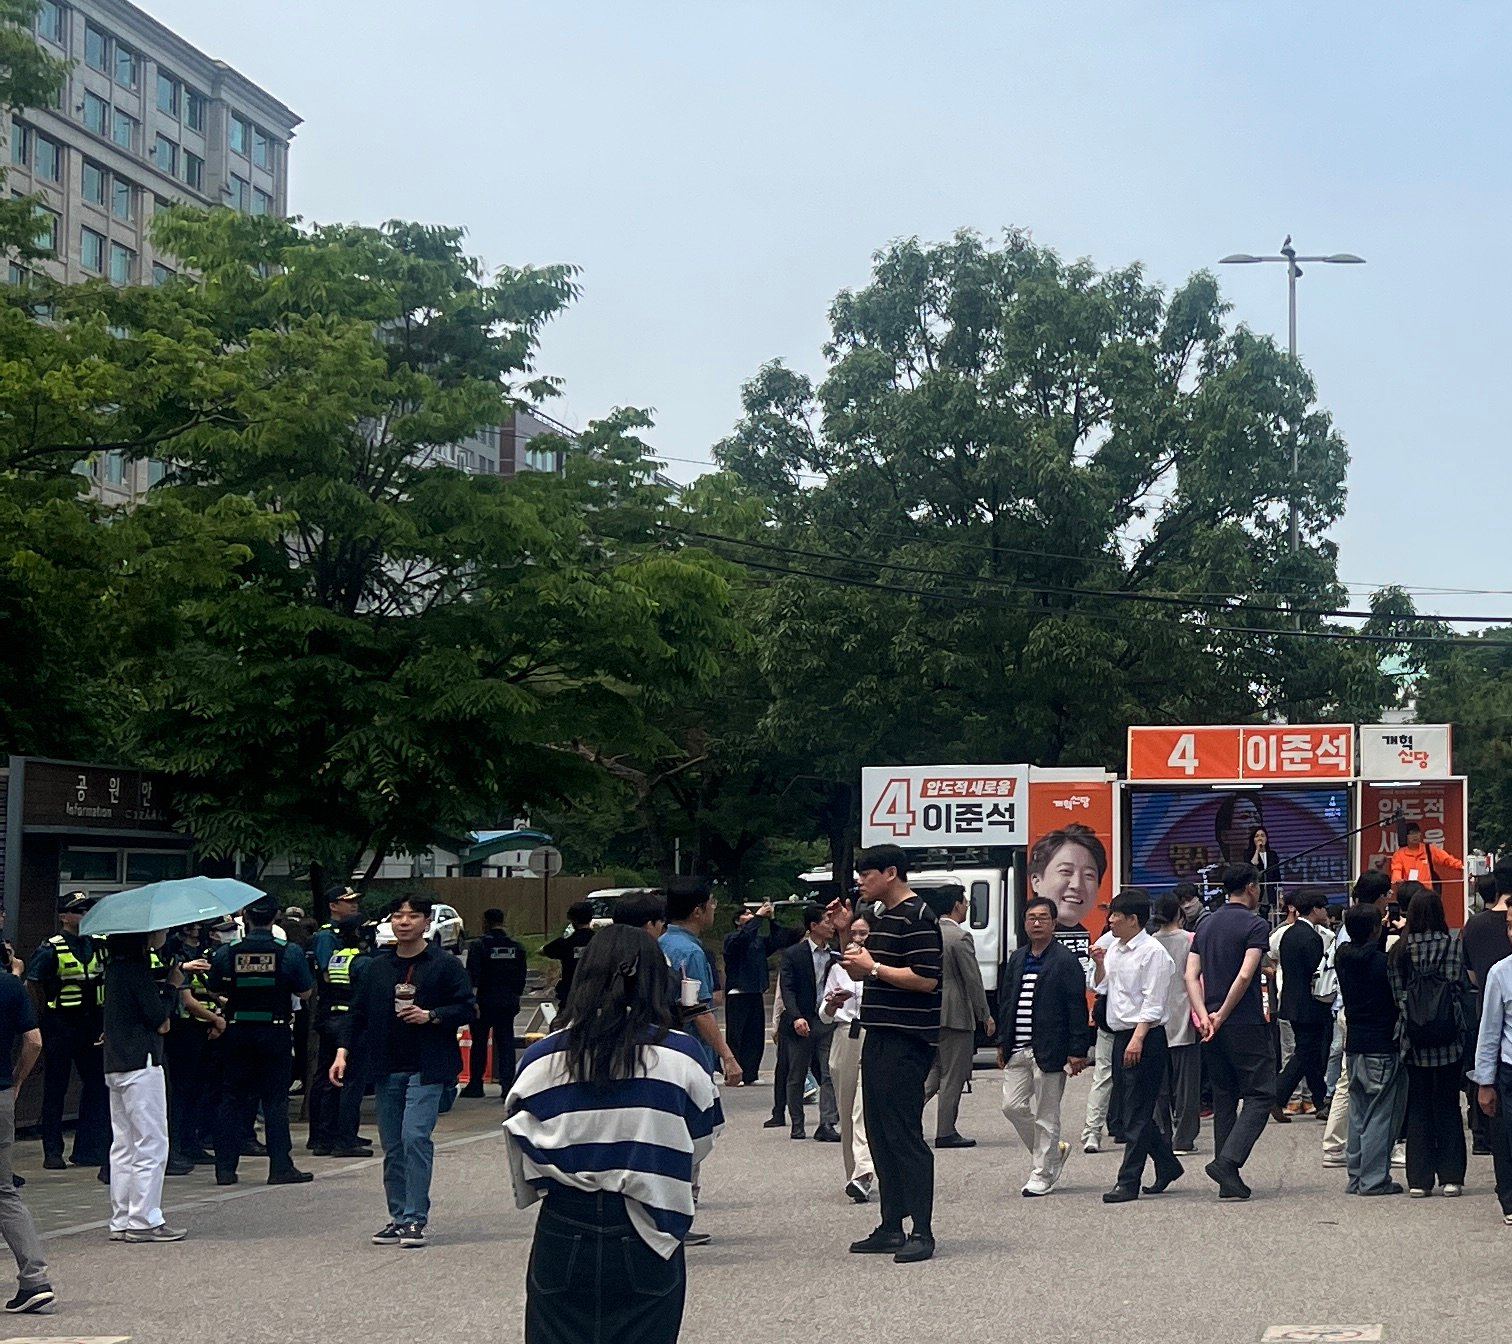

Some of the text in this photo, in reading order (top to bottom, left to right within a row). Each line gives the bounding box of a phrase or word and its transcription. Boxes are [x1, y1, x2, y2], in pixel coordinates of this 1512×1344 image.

[1167, 734, 1199, 775] 4
[1246, 734, 1347, 772] 이준석
[1382, 735, 1413, 750] 개혁
[1398, 750, 1429, 768] 신당
[926, 780, 1011, 796] 압도적 새로움
[870, 778, 916, 837] 4
[923, 803, 1015, 833] 이준석
